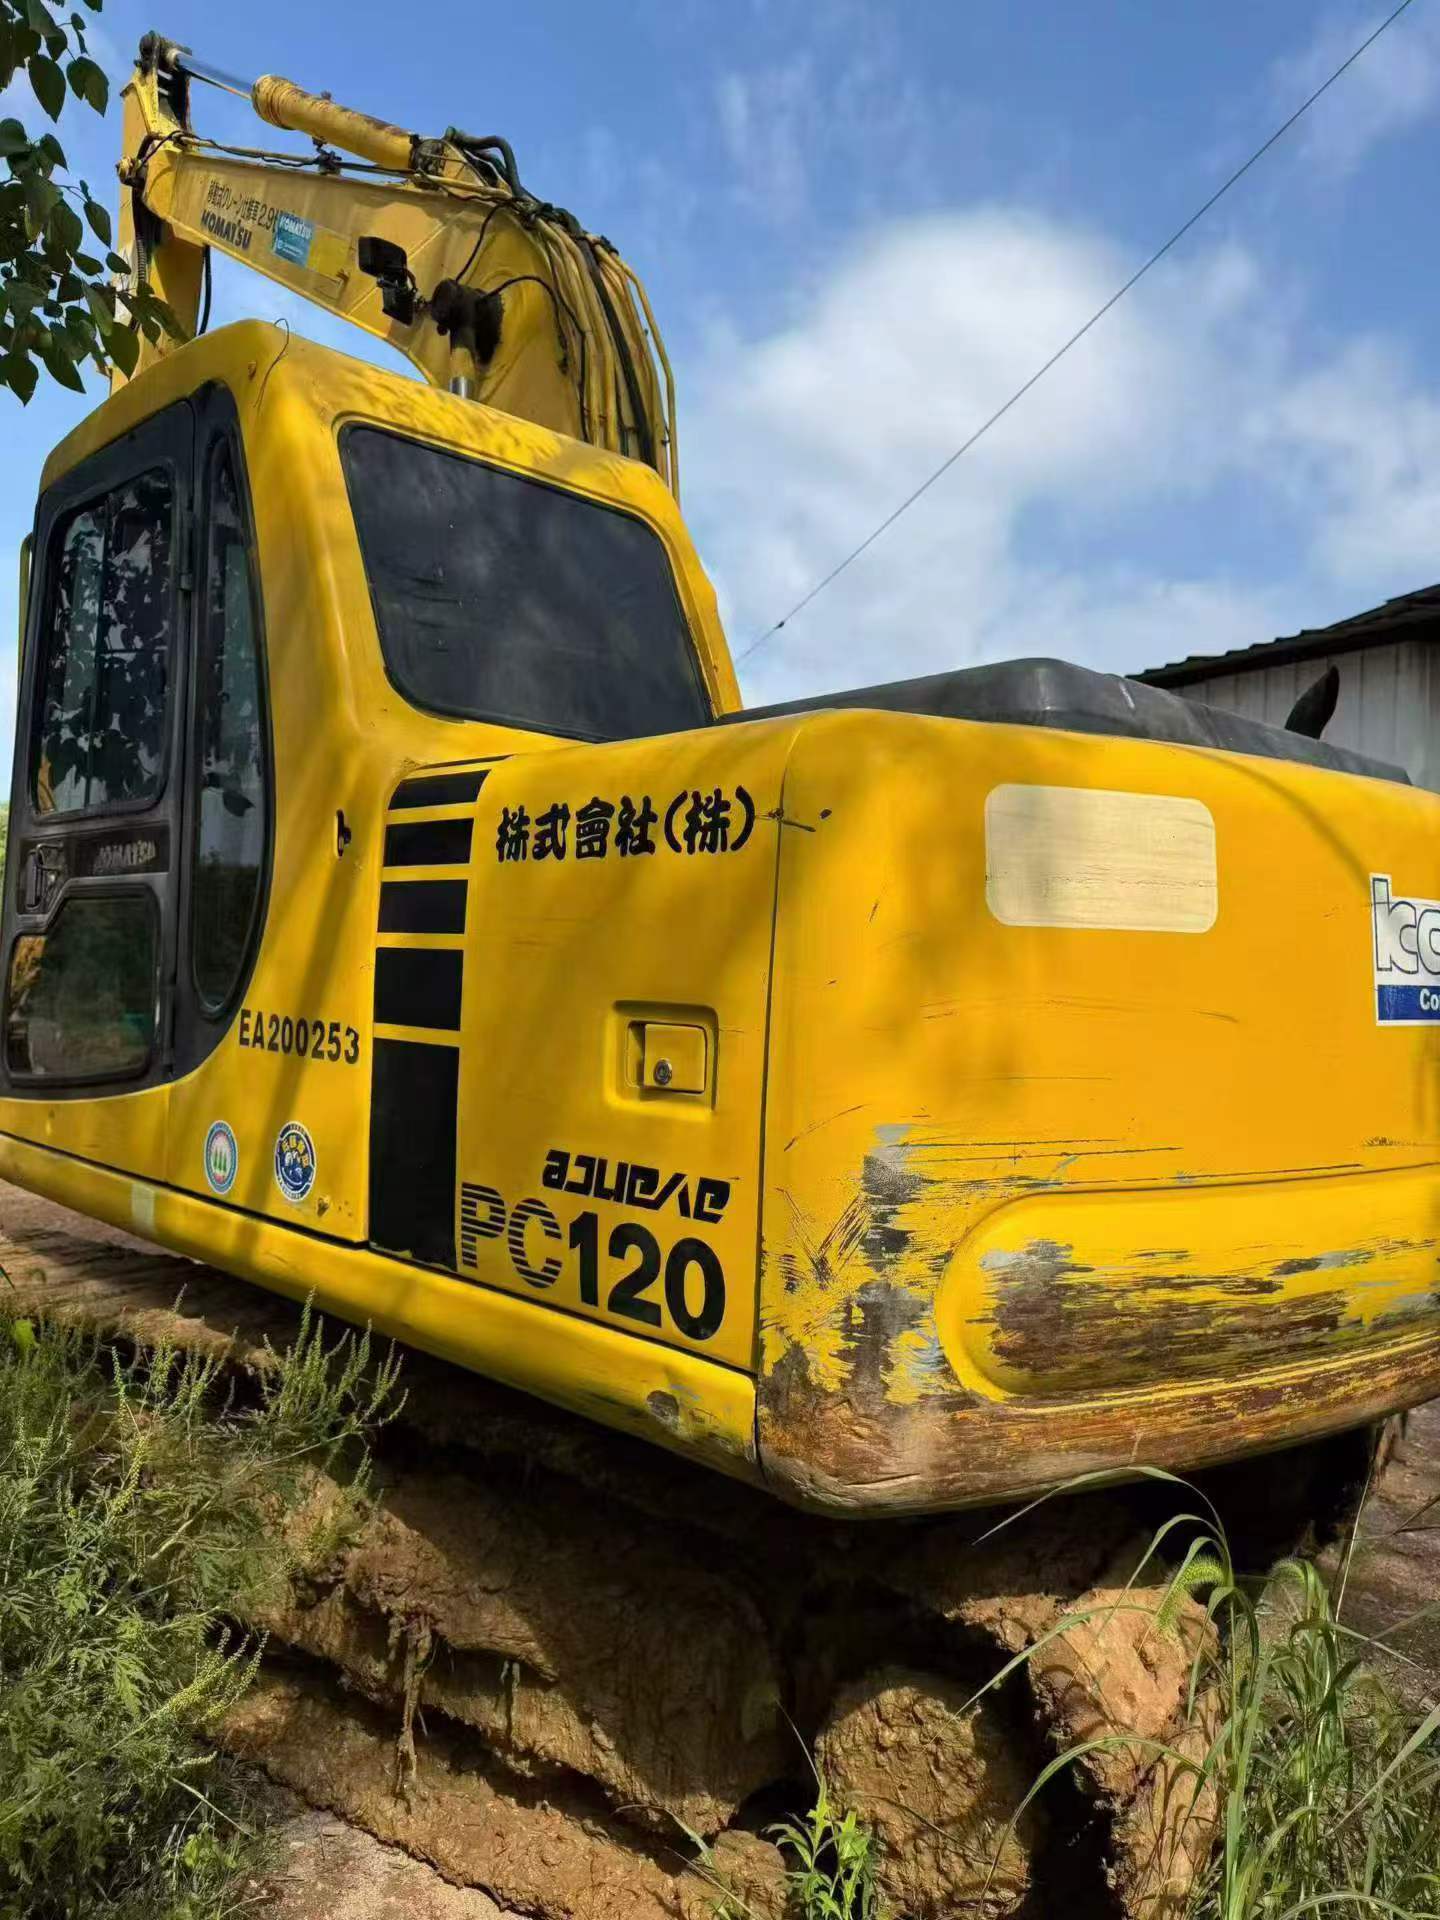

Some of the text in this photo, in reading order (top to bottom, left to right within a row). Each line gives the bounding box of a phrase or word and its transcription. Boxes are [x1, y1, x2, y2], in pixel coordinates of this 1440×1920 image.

[201, 208, 253, 250] KOMATSU
[1420, 988, 1440, 1011] Co
[239, 1009, 360, 1064] EA200253
[461, 1181, 726, 1341] PC120
